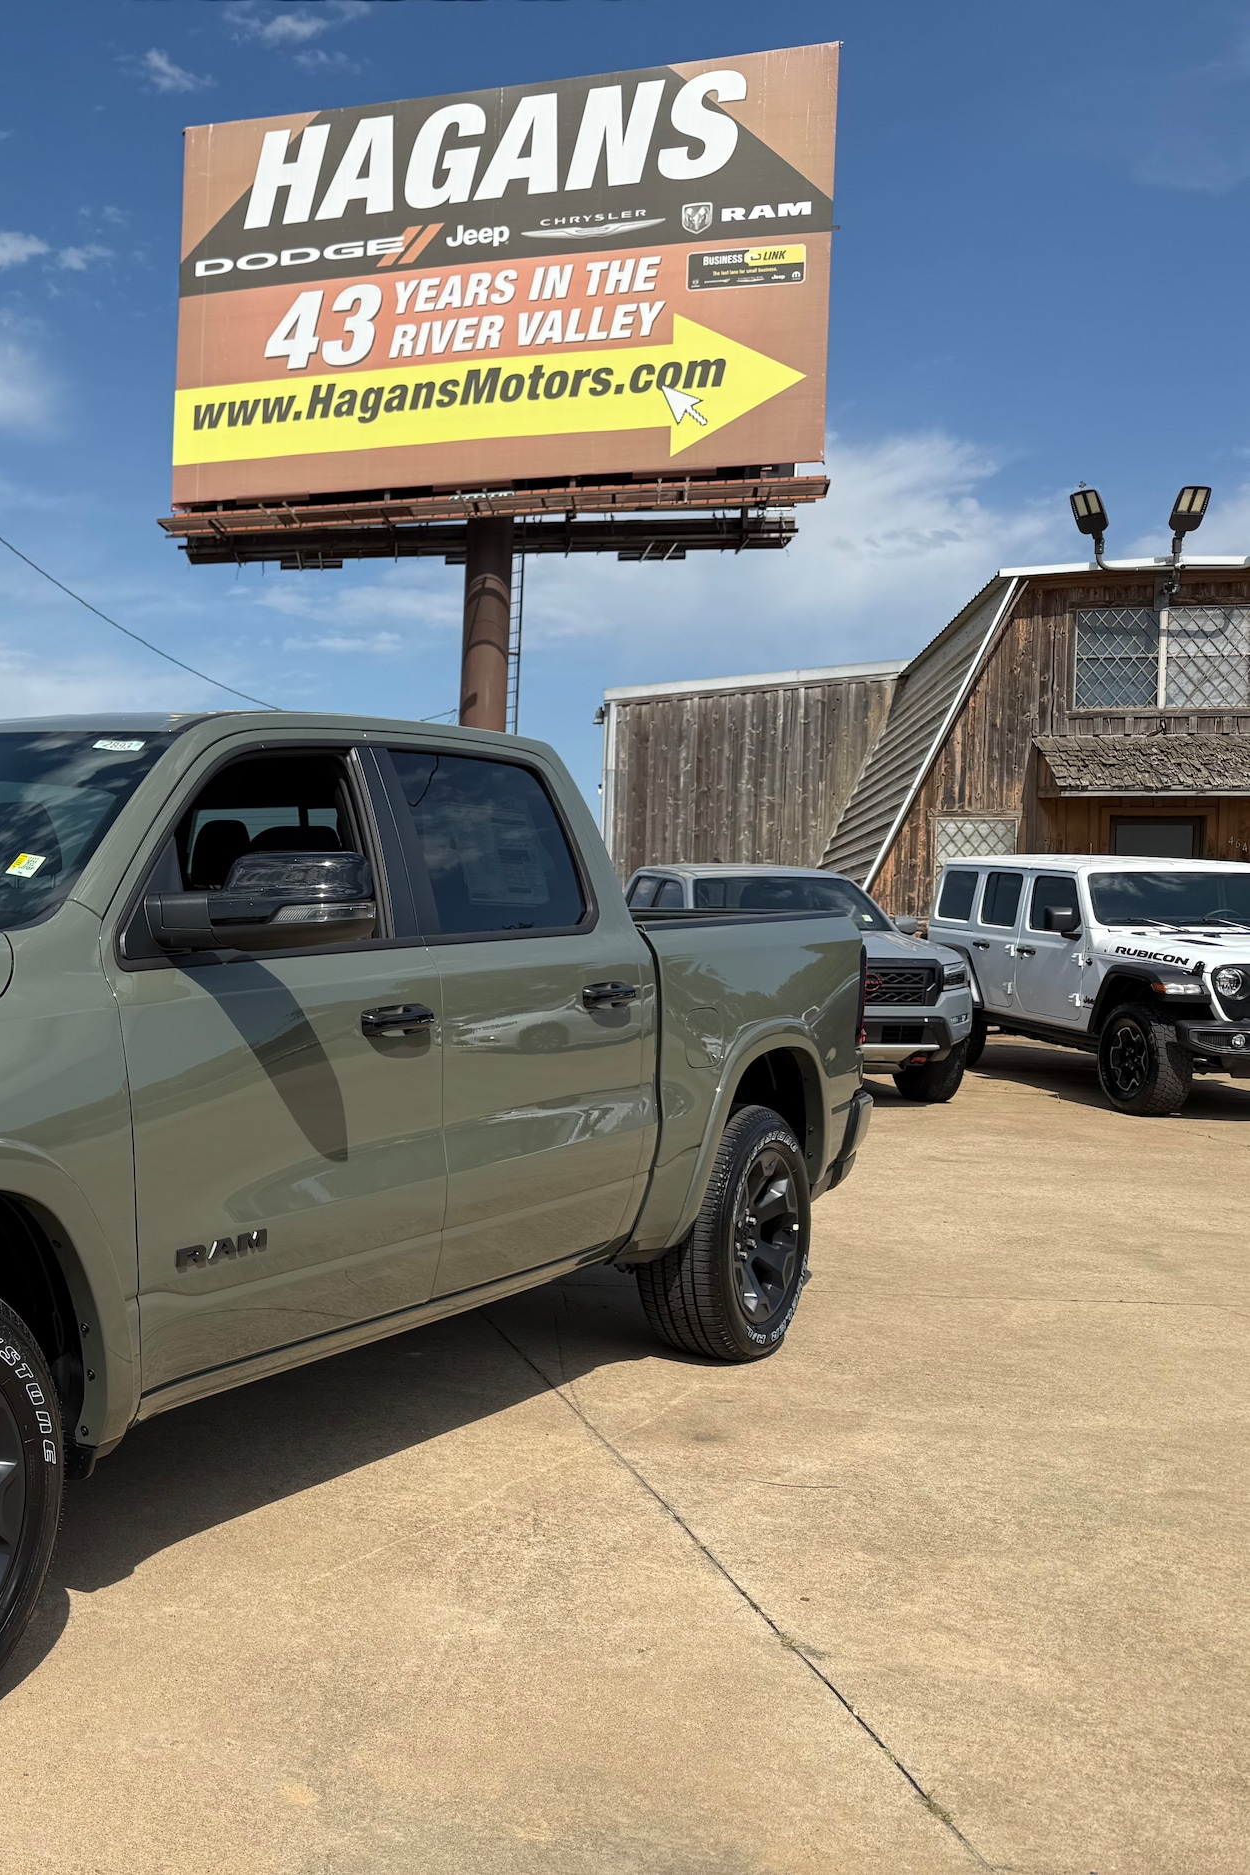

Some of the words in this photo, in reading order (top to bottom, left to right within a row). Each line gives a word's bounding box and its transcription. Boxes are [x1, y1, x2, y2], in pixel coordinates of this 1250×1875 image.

[243, 69, 748, 229] HAGANS
[540, 209, 647, 226] CHRYSLER
[721, 201, 812, 222] RAM
[195, 235, 405, 277] DODGE
[446, 224, 510, 247] Jeep
[702, 254, 743, 266] BUSINESS
[763, 250, 787, 261] LINK
[393, 268, 518, 315] YEARS
[527, 263, 575, 302] IN
[584, 256, 662, 297] THE
[263, 284, 383, 371] 43
[388, 314, 506, 360] RIVER
[517, 300, 667, 346] VALLEY
[192, 357, 727, 431] www.HagansMotors.com
[1115, 946, 1190, 966] RUBICON
[175, 1228, 268, 1271] RAM
